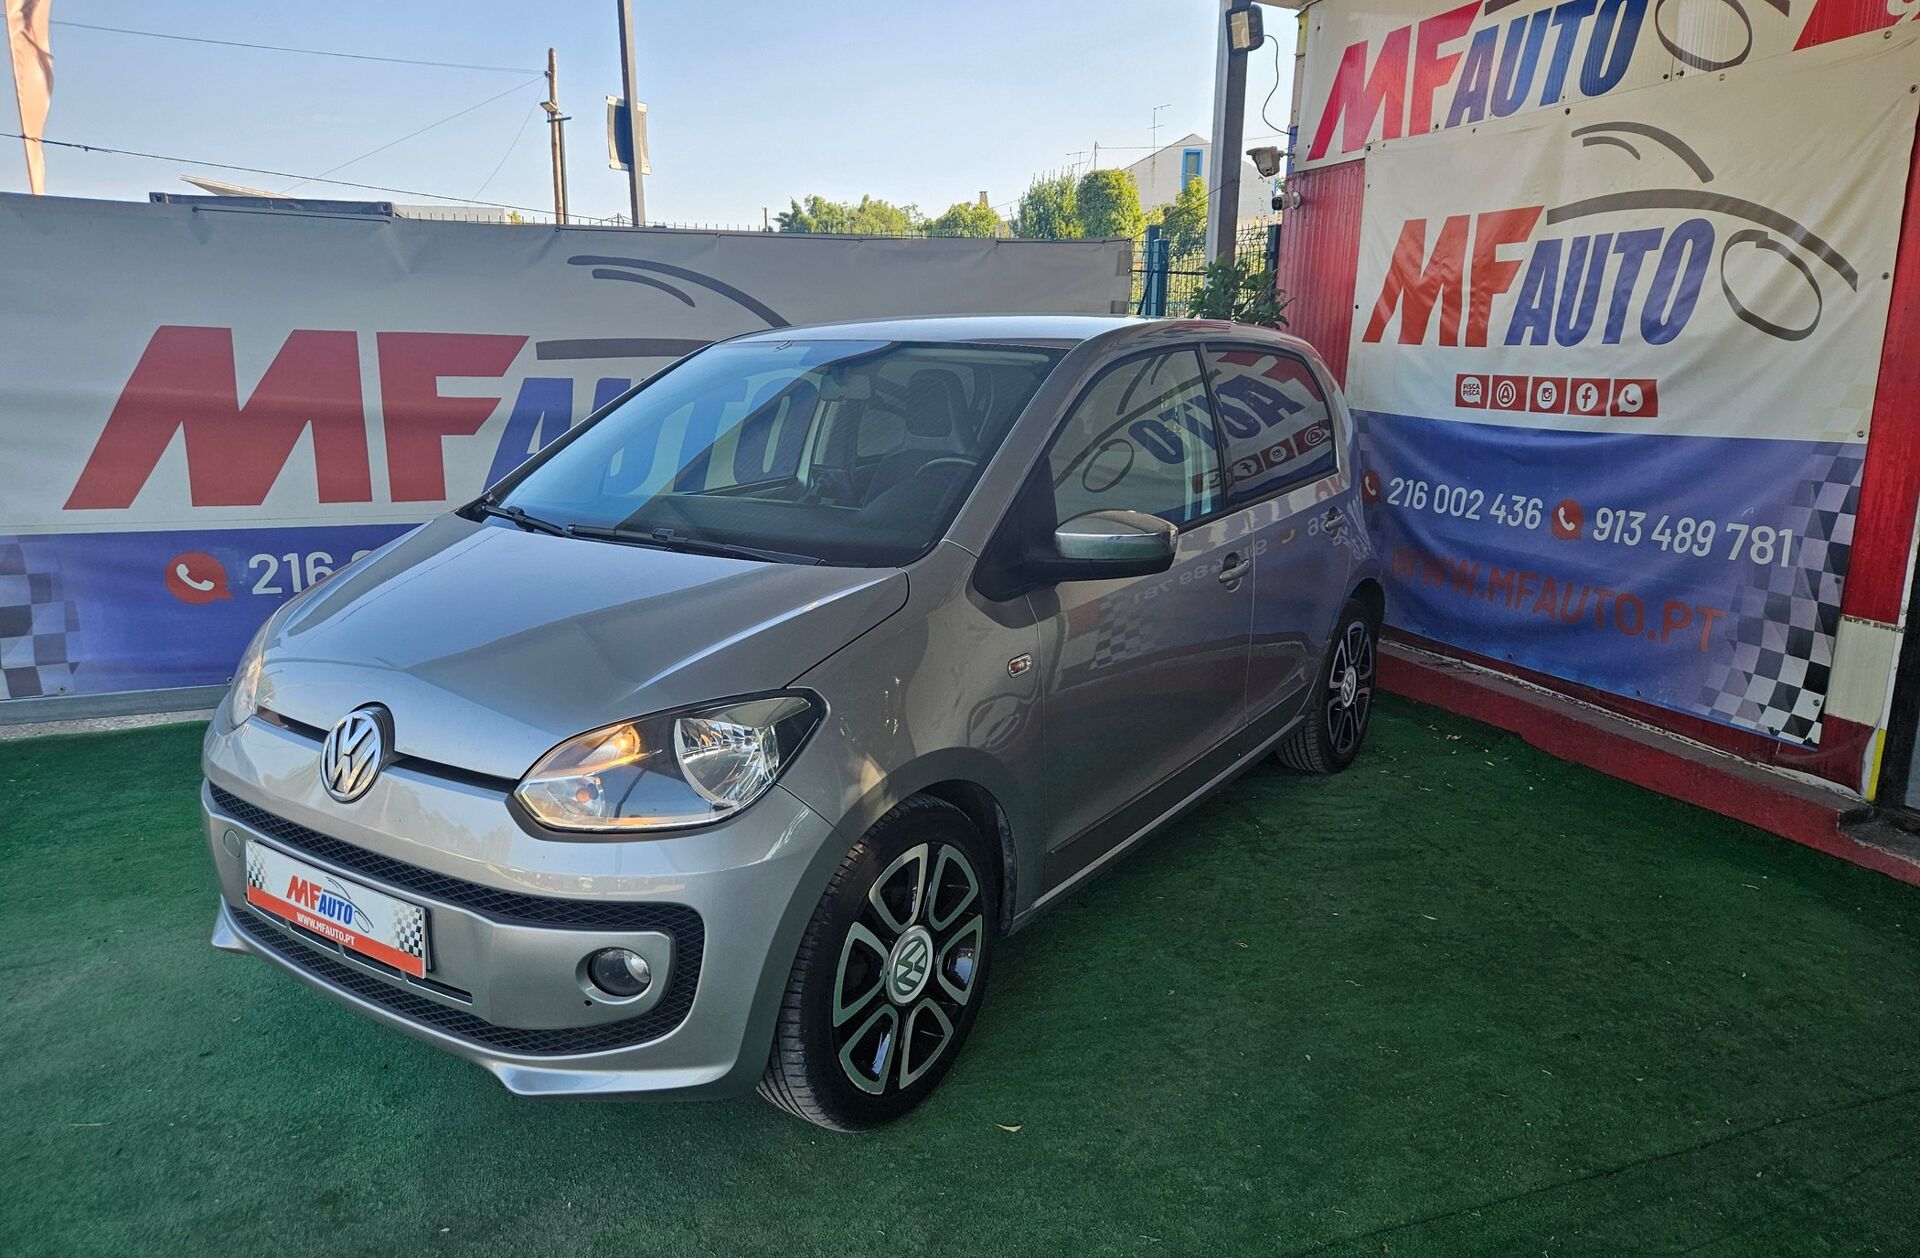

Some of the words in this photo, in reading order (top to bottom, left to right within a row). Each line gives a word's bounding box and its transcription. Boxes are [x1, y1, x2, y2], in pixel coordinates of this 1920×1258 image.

[1387, 477, 1428, 510] 216
[1433, 484, 1484, 520] 002
[1489, 493, 1543, 529] 436
[1593, 507, 1646, 546] 913
[1650, 515, 1716, 557] 489
[1726, 523, 1793, 568] 781
[1392, 545, 1726, 653] WWW.MFAUTO.PT
[296, 912, 355, 946] WWW.MFAUTO.PT
